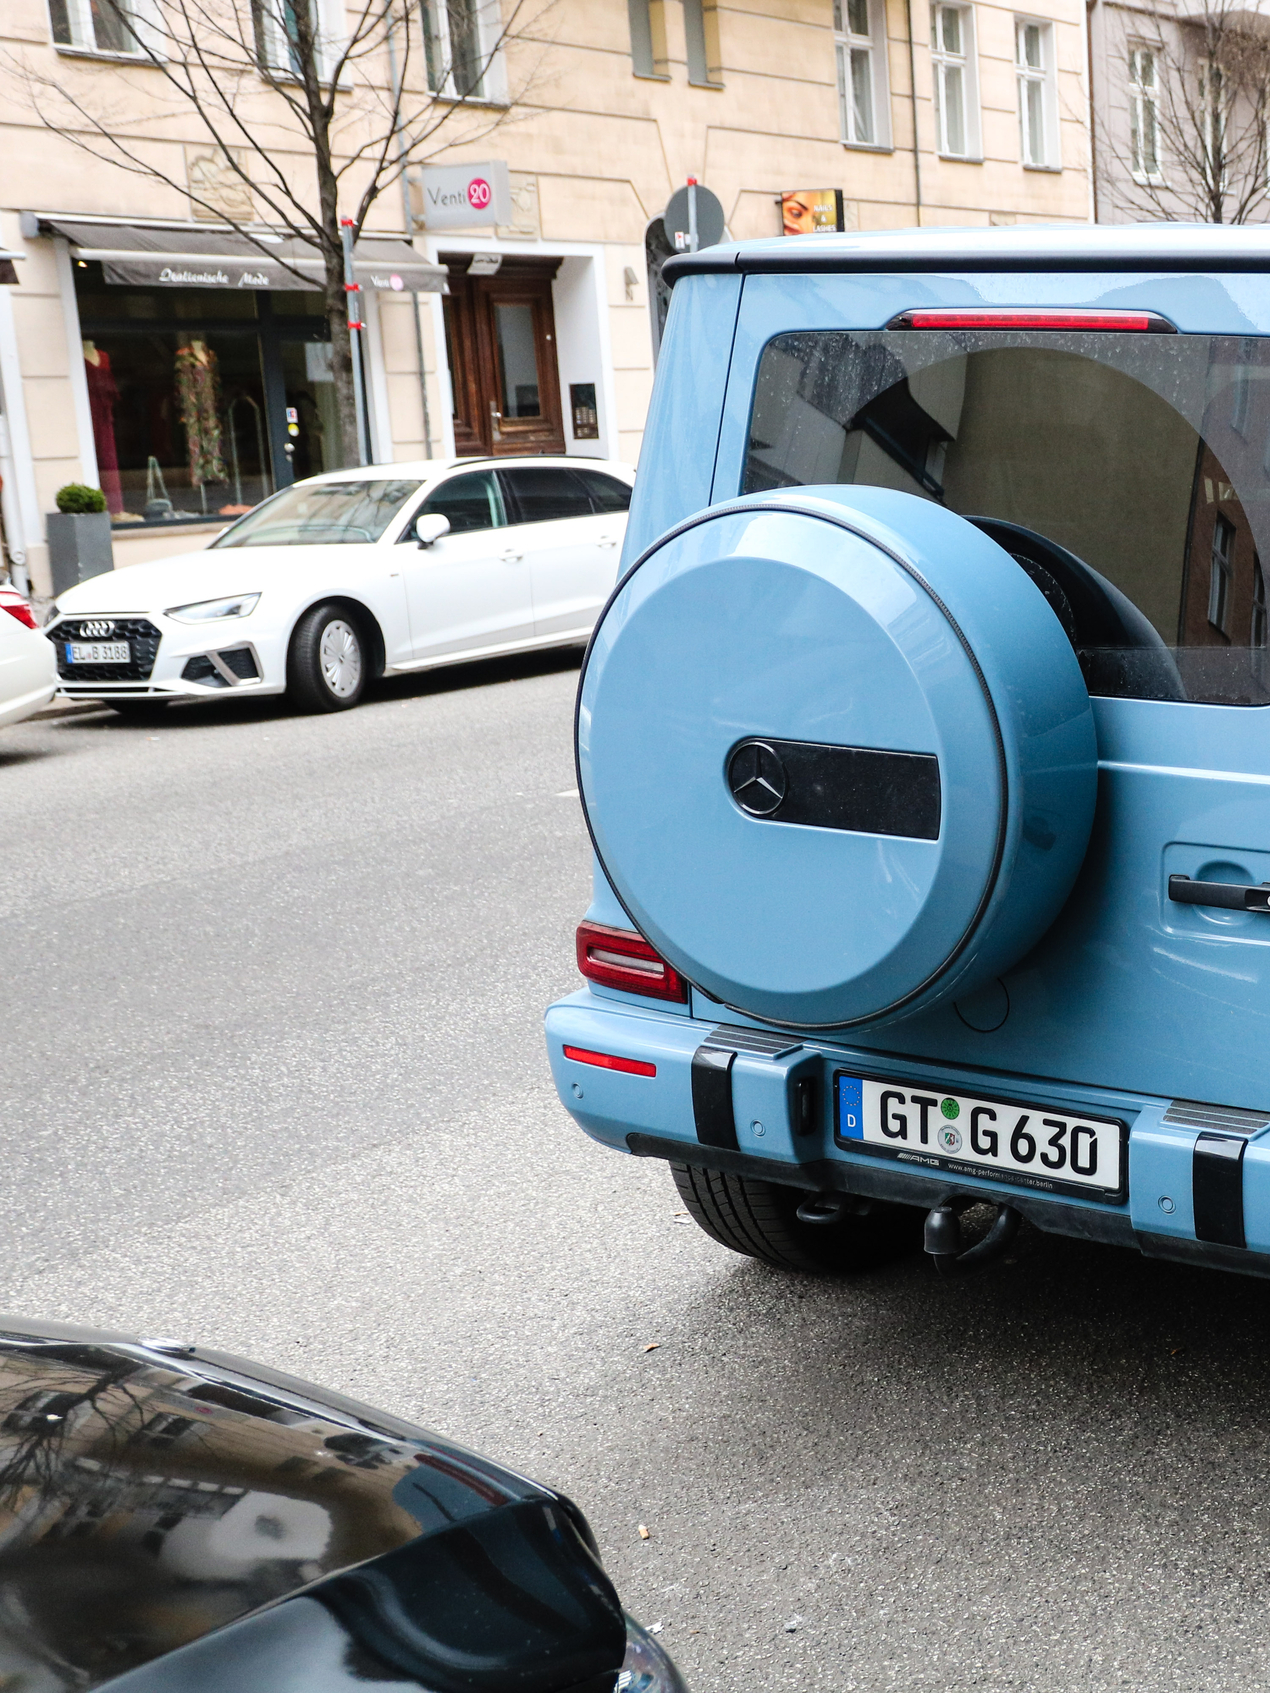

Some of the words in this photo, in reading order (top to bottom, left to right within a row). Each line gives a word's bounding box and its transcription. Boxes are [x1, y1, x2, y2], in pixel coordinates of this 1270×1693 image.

[427, 186, 467, 206] Venti
[470, 183, 490, 204] 20
[72, 646, 85, 660] EL
[879, 1089, 938, 1145] GT
